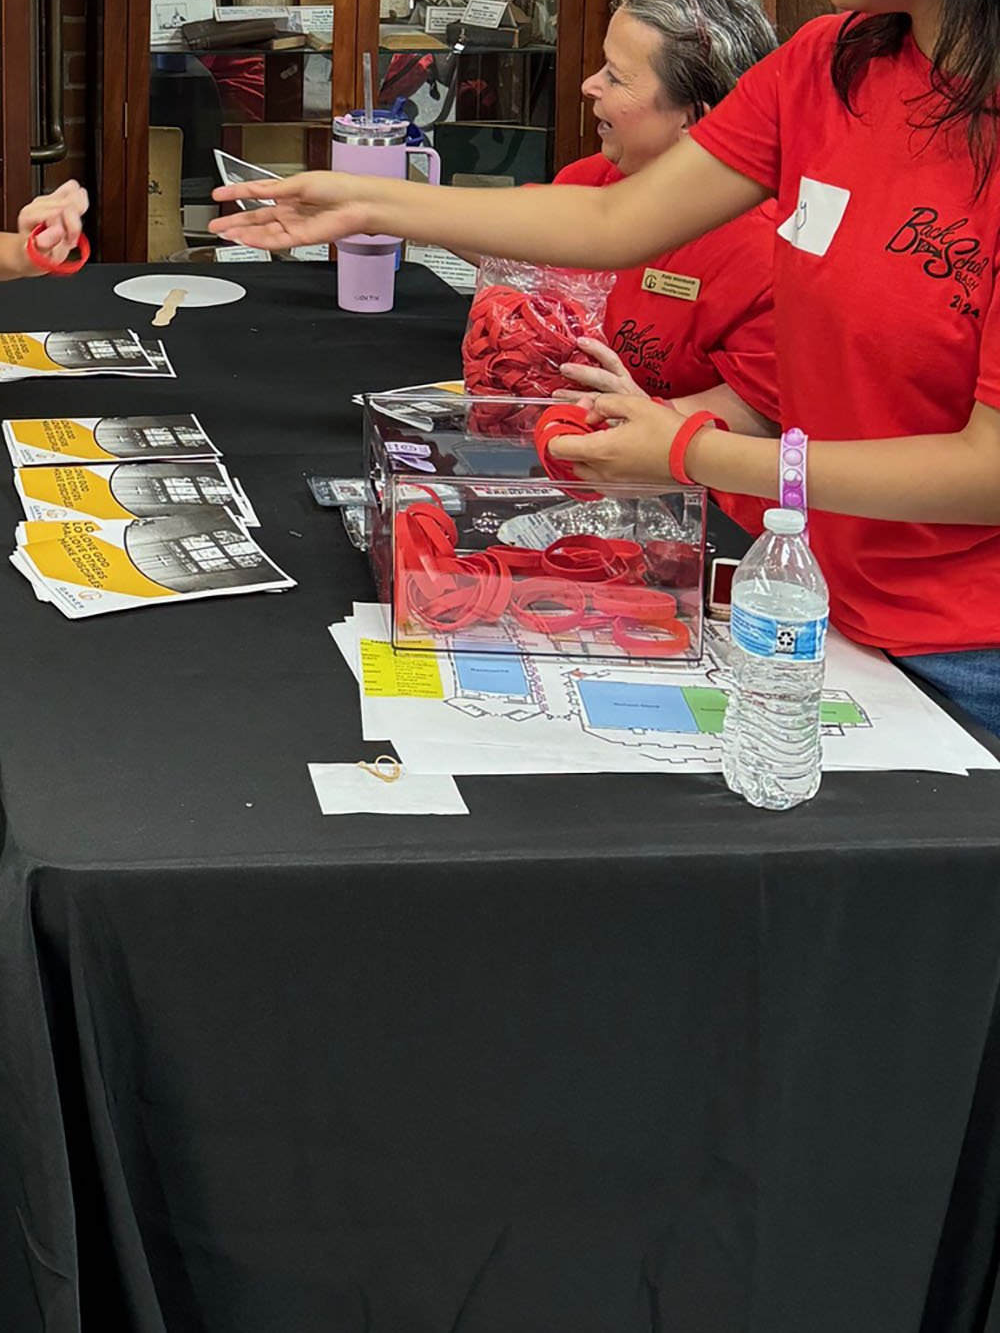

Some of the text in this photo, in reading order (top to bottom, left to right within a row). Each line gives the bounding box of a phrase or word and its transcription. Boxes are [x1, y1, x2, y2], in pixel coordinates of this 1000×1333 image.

[885, 207, 969, 253] Back
[57, 537, 78, 558] MAKE
[71, 555, 104, 589] DISCIPLES
[69, 537, 108, 581] LOVE OTHERS
[79, 533, 111, 568] LOVE GOD
